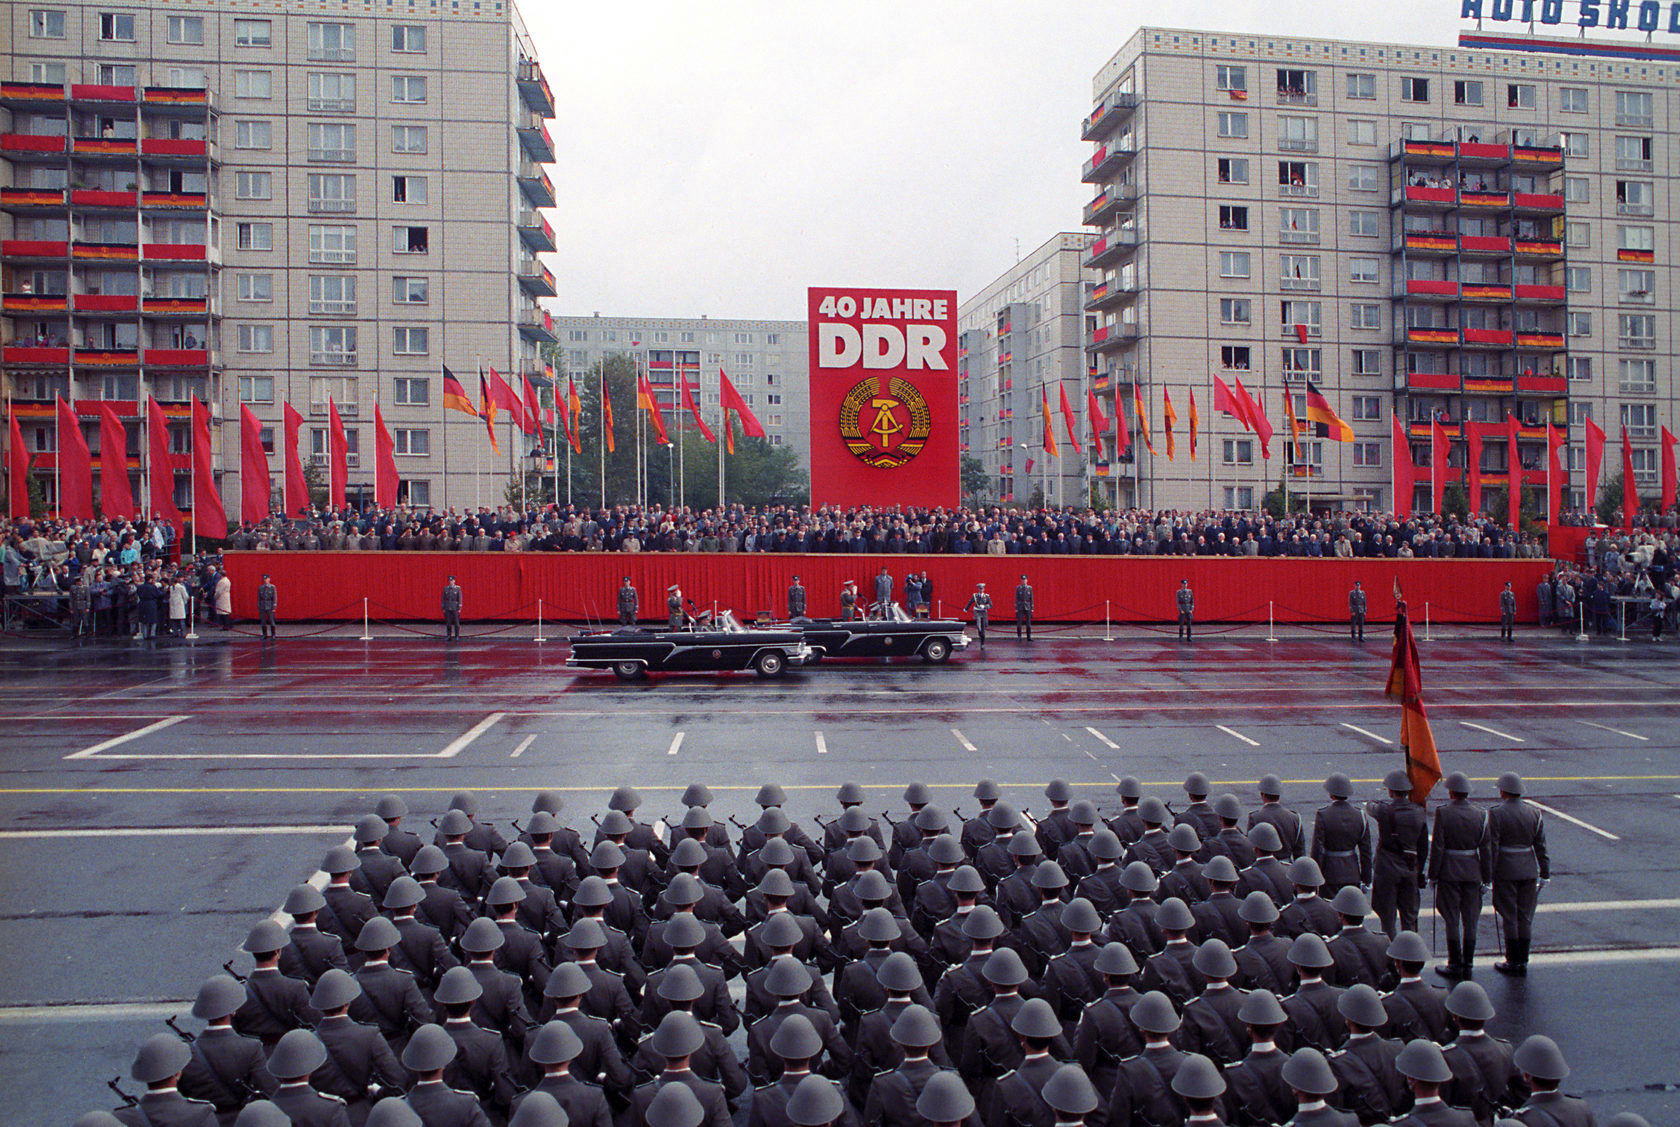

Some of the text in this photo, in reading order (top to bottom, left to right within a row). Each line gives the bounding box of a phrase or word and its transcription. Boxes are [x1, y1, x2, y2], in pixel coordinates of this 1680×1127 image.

[1460, 0, 1562, 25] AUTO
[818, 296, 948, 320] 40 JAHRE
[818, 322, 949, 371] DDR
